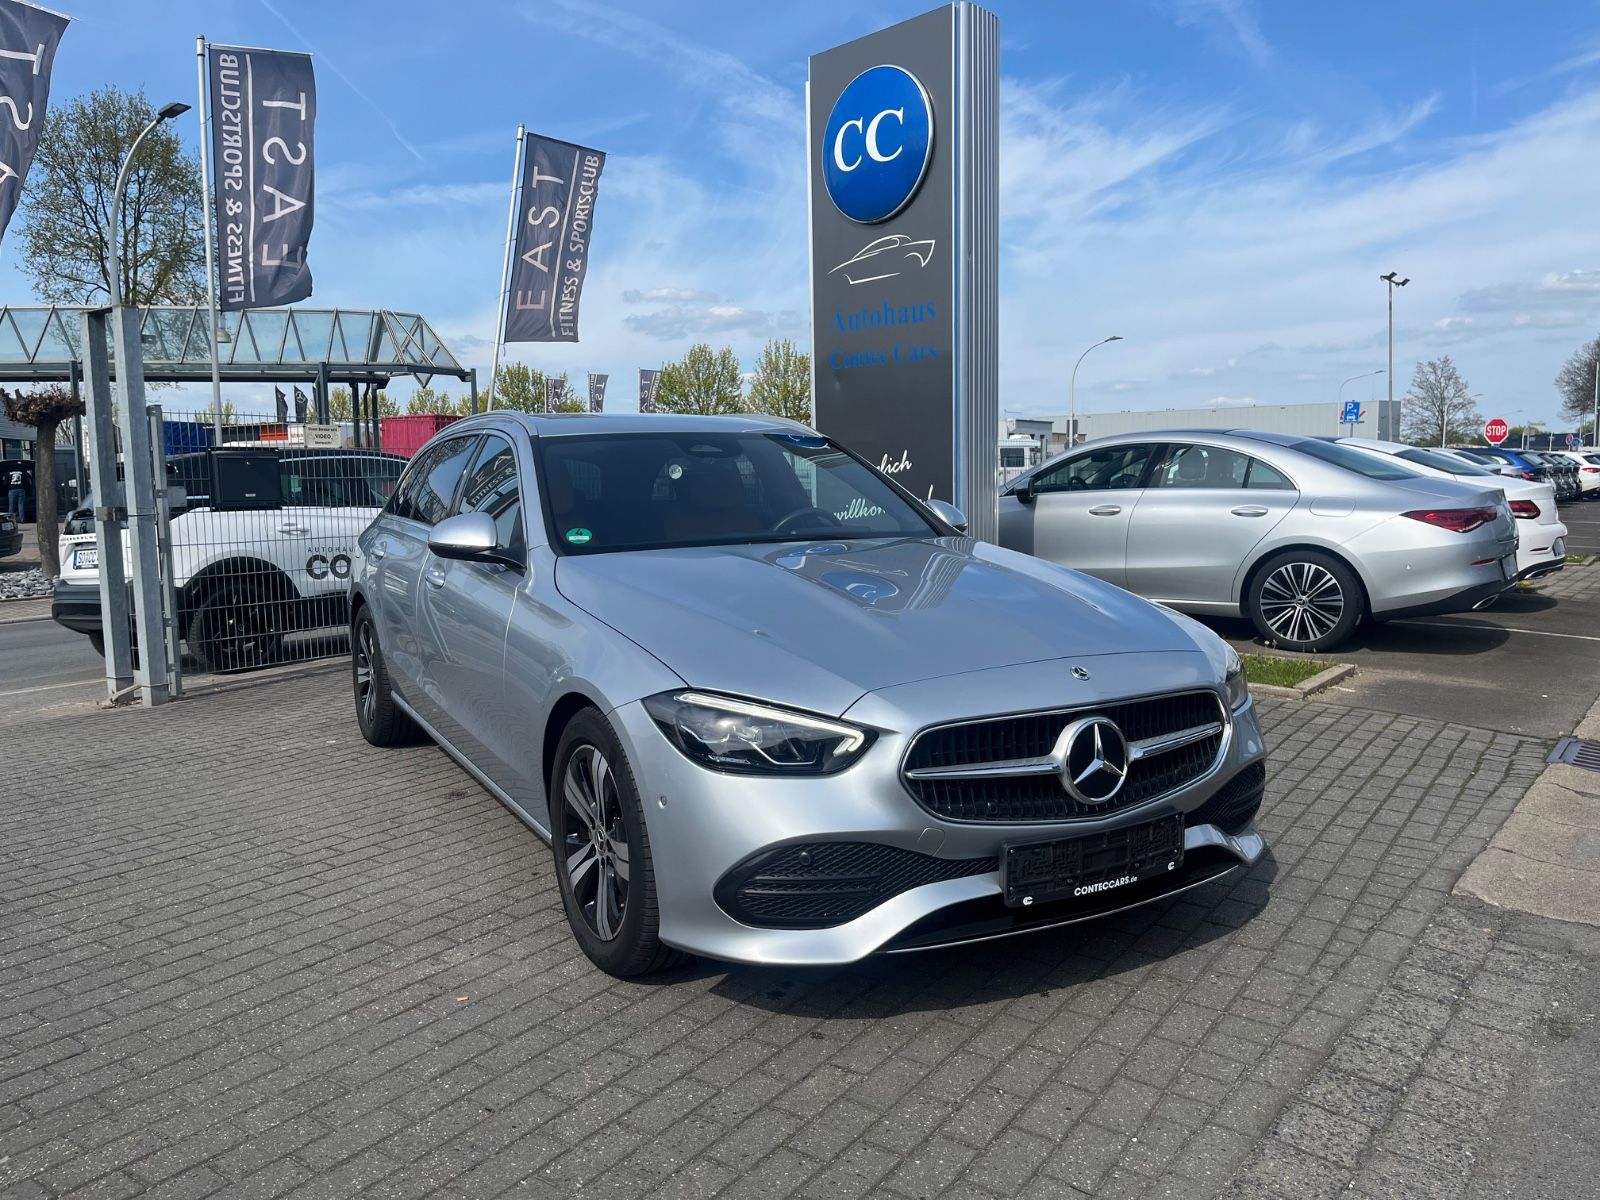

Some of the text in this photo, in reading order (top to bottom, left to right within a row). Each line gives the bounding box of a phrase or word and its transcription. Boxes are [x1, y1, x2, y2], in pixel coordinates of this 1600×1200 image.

[833, 106, 904, 172] CC
[516, 165, 564, 310] EAST
[559, 154, 600, 337] FITNESS & SPORTSCLUB
[831, 300, 938, 333] Autohaus
[892, 344, 938, 366] Cars
[1346, 403, 1354, 412] P
[1486, 425, 1507, 437] STOP
[876, 449, 912, 474] lich
[306, 554, 351, 580] CO
[1074, 875, 1138, 897] CONTECCARS.de
